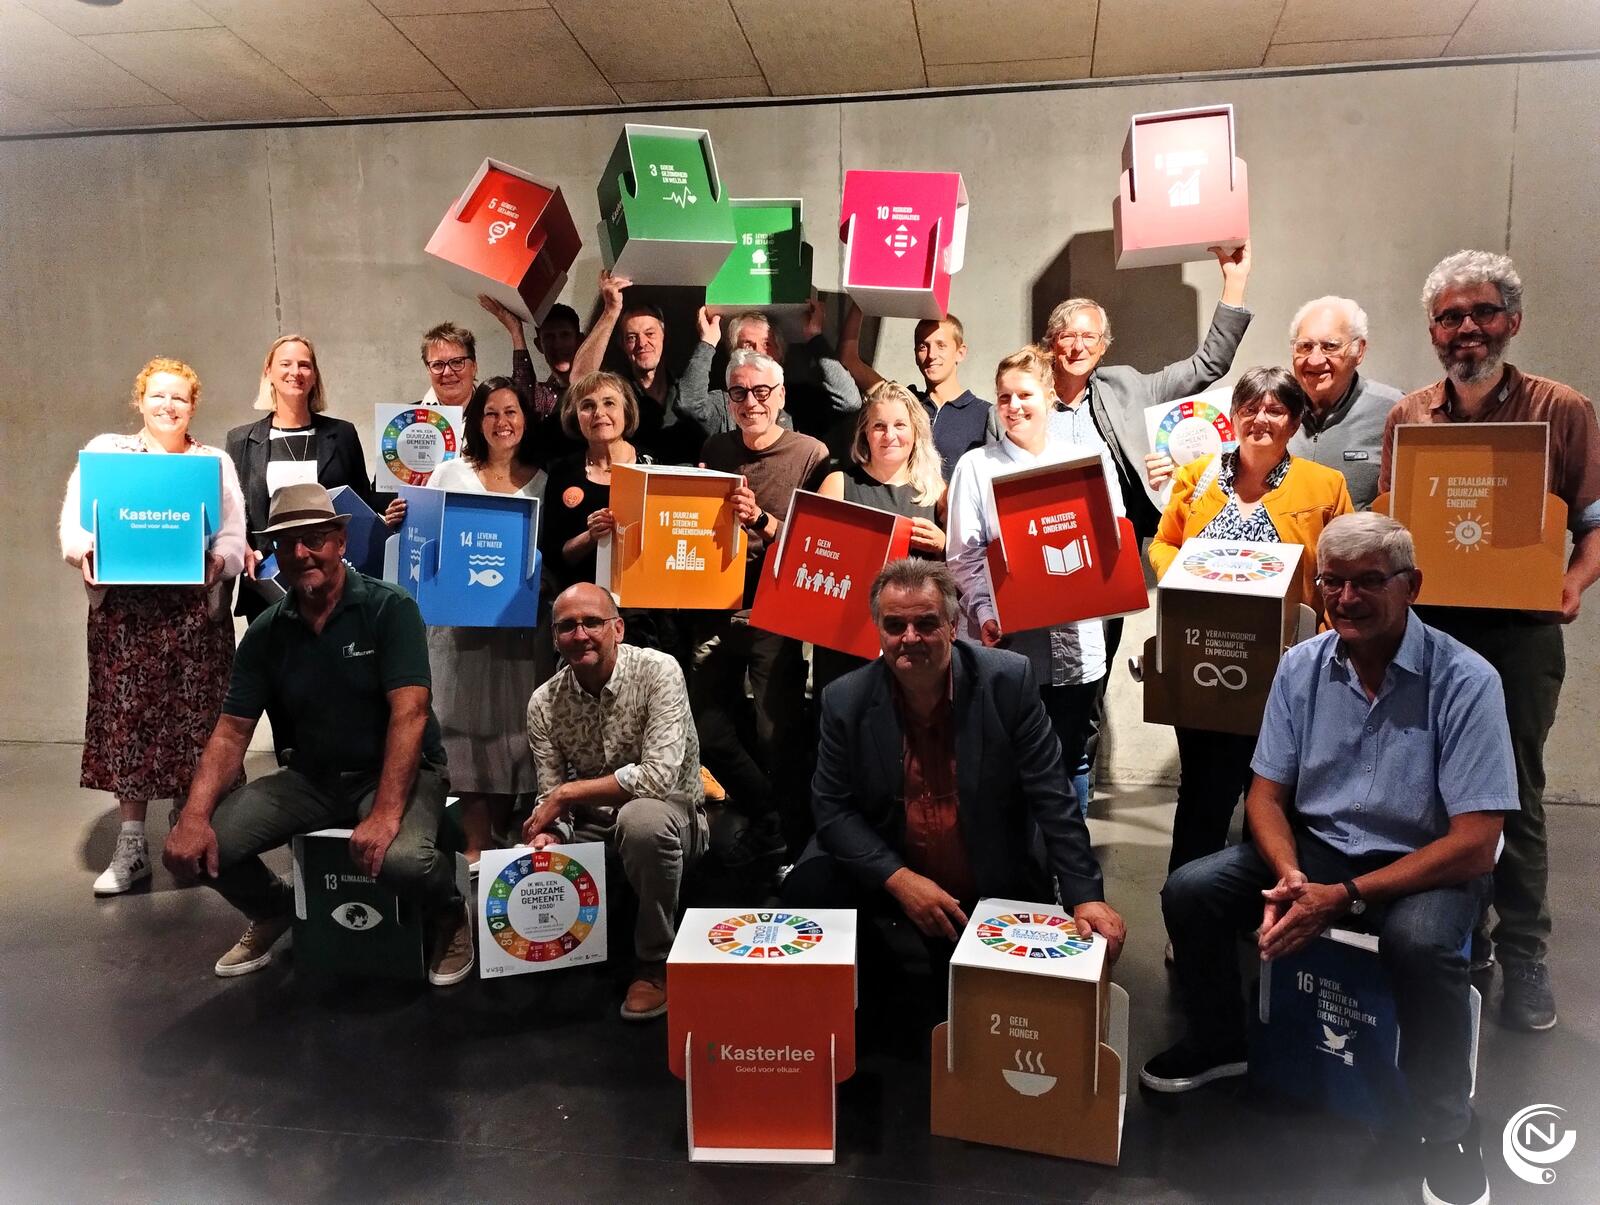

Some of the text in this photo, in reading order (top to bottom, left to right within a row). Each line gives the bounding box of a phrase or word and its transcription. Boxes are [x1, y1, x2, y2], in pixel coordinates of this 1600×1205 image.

[650, 164, 657, 176] 3
[488, 198, 498, 209] 5
[877, 206, 889, 220] 10
[1429, 477, 1440, 497] 7
[1448, 477, 1508, 487] BETAALBARE EN
[1447, 488, 1489, 497] DUURZAME
[1446, 498, 1477, 508] ENERGIE
[120, 508, 190, 521] Kasterlee
[659, 511, 670, 527] 11
[1028, 519, 1038, 536] 4
[1043, 521, 1077, 534] ONDERWIJS
[461, 532, 472, 547] 14
[477, 540, 503, 549] HET WATER
[804, 536, 811, 552] 1
[817, 538, 831, 548] GEEN
[815, 547, 840, 560] ARMOEDE
[1185, 628, 1200, 645] 12
[1205, 639, 1245, 650] CONSUMPTIE
[1205, 647, 1249, 659] EN PRODUCTIE
[324, 873, 337, 890] 13
[521, 886, 565, 897] DUURZAME
[521, 894, 565, 905] GEMEENTE
[1297, 971, 1314, 993] 16
[1319, 989, 1359, 1008] JUSTITIE EN
[1317, 1010, 1350, 1028] DIENSTEN
[1318, 999, 1377, 1027] STERKE PUBLIEKE
[990, 1014, 1001, 1035] 2
[1009, 1016, 1029, 1028] GEEN
[1009, 1028, 1039, 1041] HONGER
[720, 1044, 816, 1062] Kasterlee
